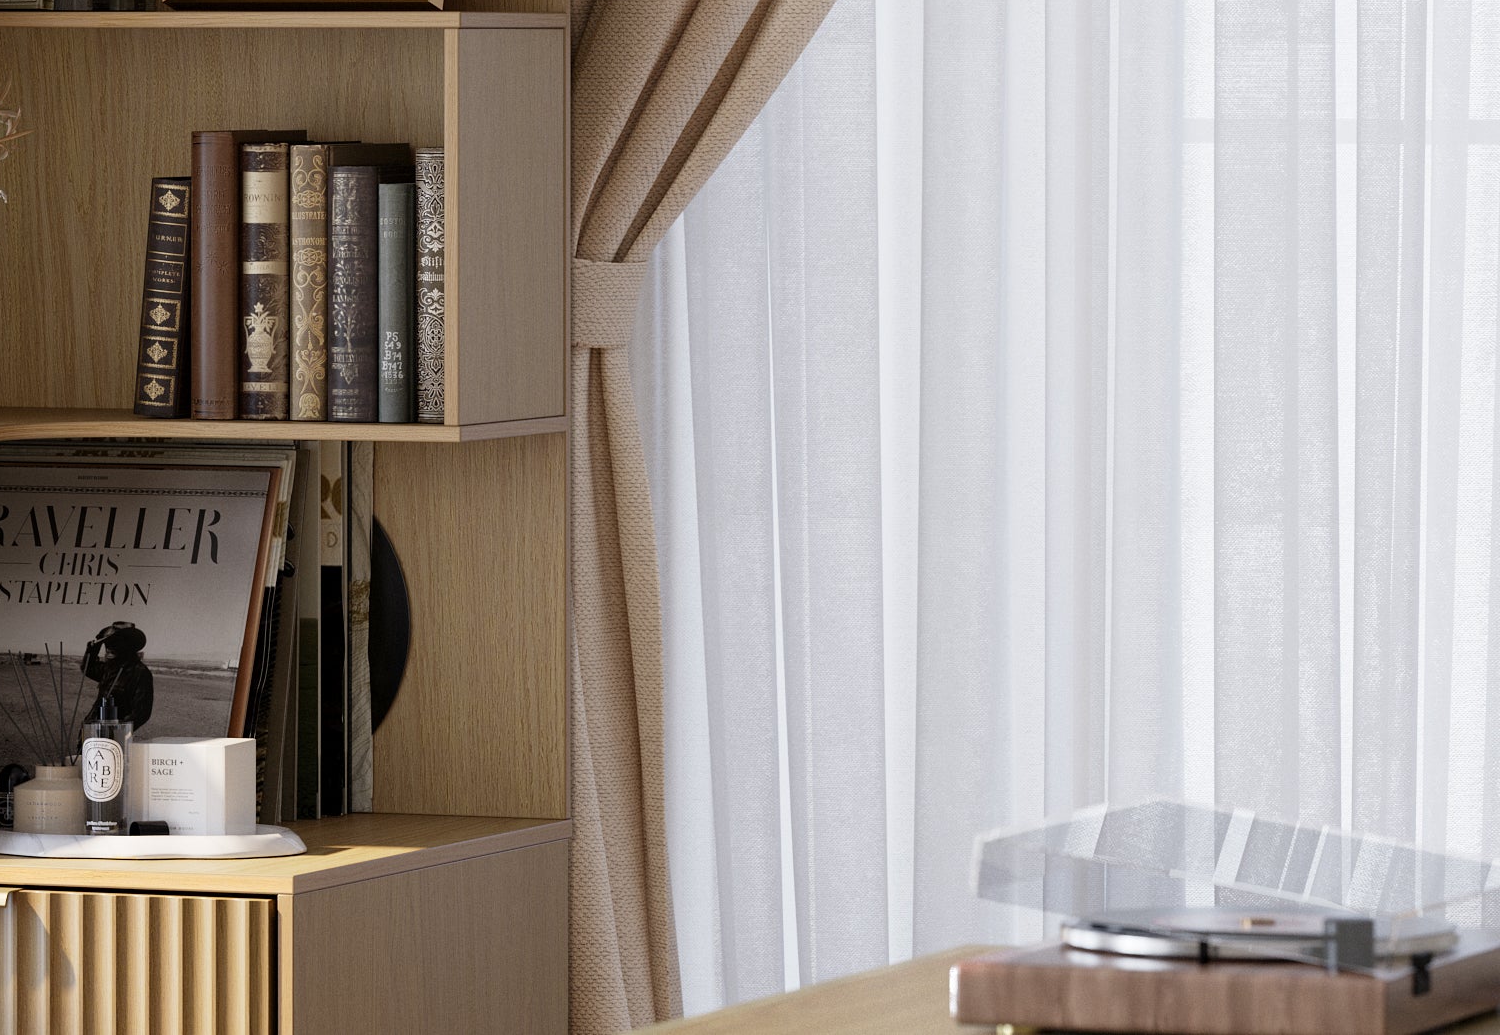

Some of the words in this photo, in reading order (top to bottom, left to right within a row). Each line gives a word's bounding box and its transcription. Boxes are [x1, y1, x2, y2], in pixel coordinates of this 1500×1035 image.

[244, 193, 285, 204] ROWNIN
[152, 234, 184, 244] URNER
[385, 331, 399, 342] PS
[39, 551, 121, 577] CHRIS
[151, 758, 177, 766] BIRCH
[151, 768, 175, 776] SAGE
